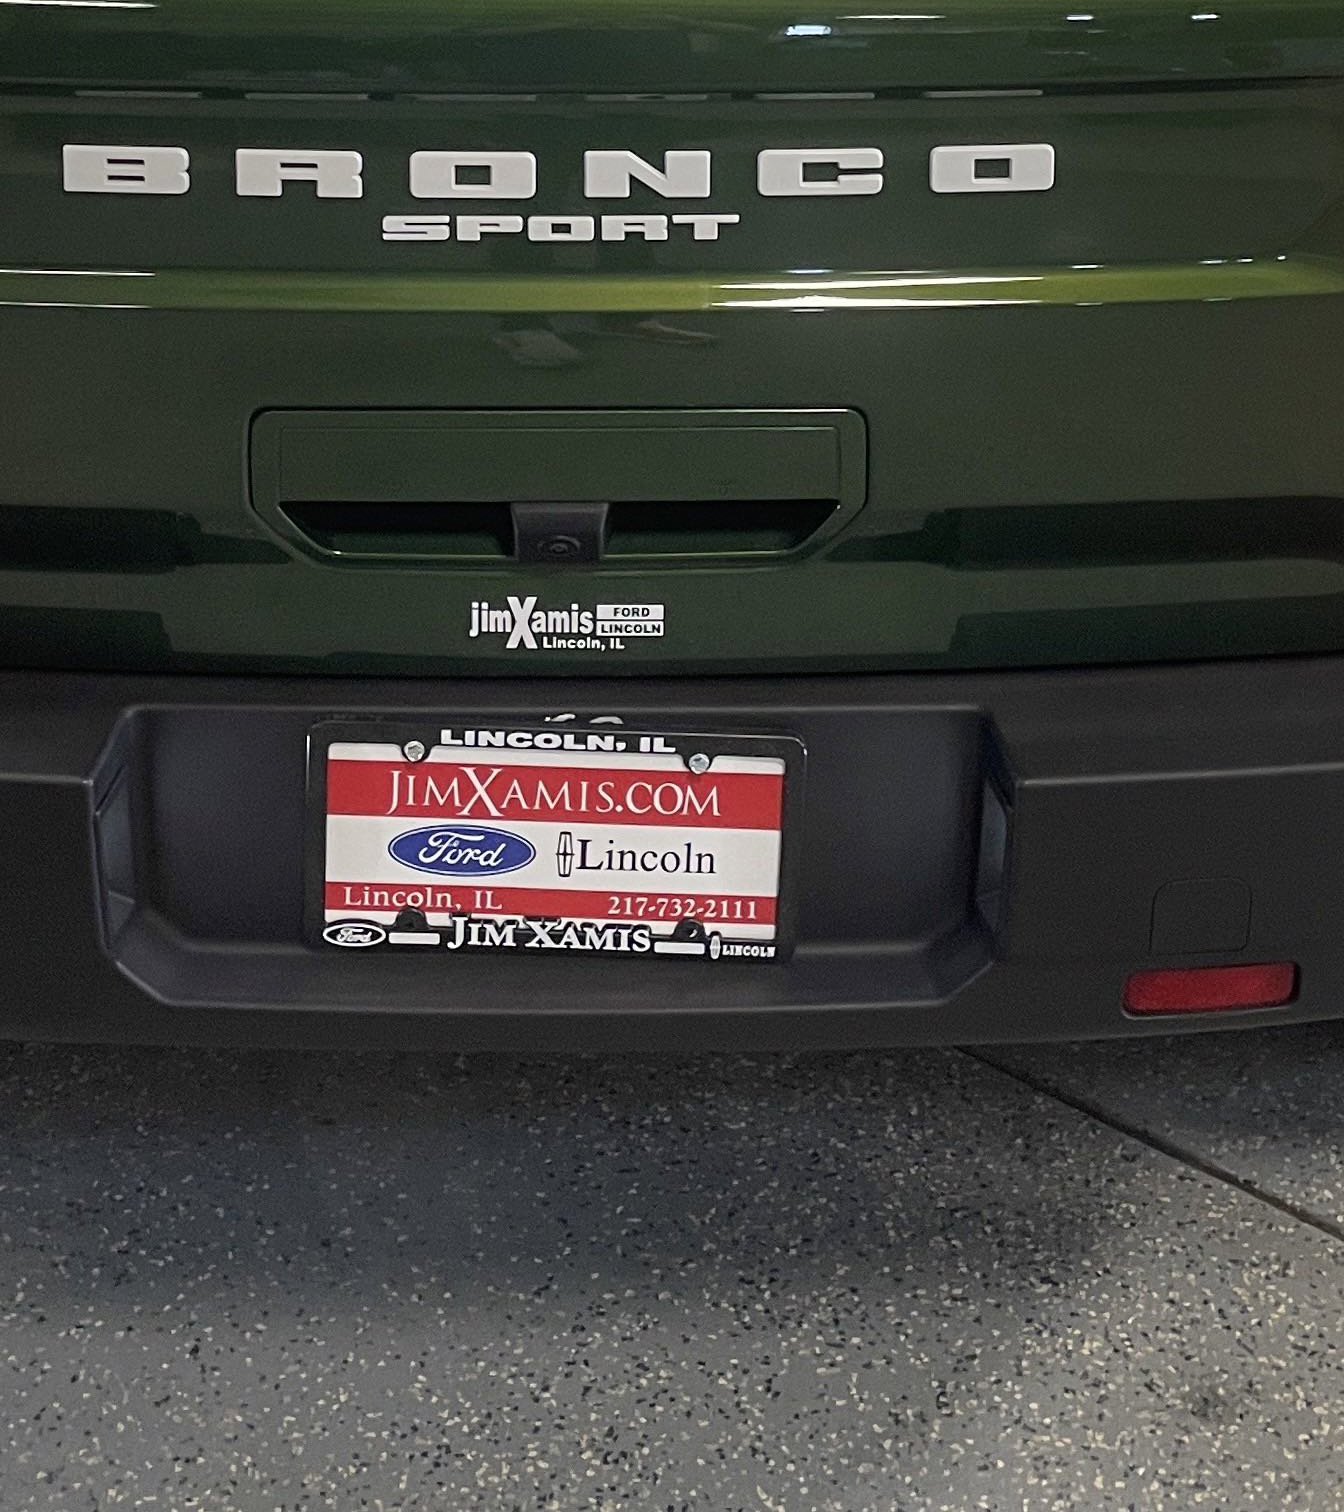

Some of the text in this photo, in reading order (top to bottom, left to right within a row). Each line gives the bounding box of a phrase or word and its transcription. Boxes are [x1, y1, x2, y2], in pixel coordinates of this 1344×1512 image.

[62, 142, 1057, 199] BRONCO
[380, 213, 741, 242] SPORT
[613, 607, 650, 618] FORD
[600, 624, 662, 635] LINCOLN
[440, 729, 676, 753] LINCOLN, IL
[418, 831, 506, 869] Ford
[576, 838, 716, 874] Lincoln
[343, 886, 503, 910] Lincoln, IL
[606, 896, 757, 919] 217-732-2111
[722, 943, 775, 959] LINCOLN
